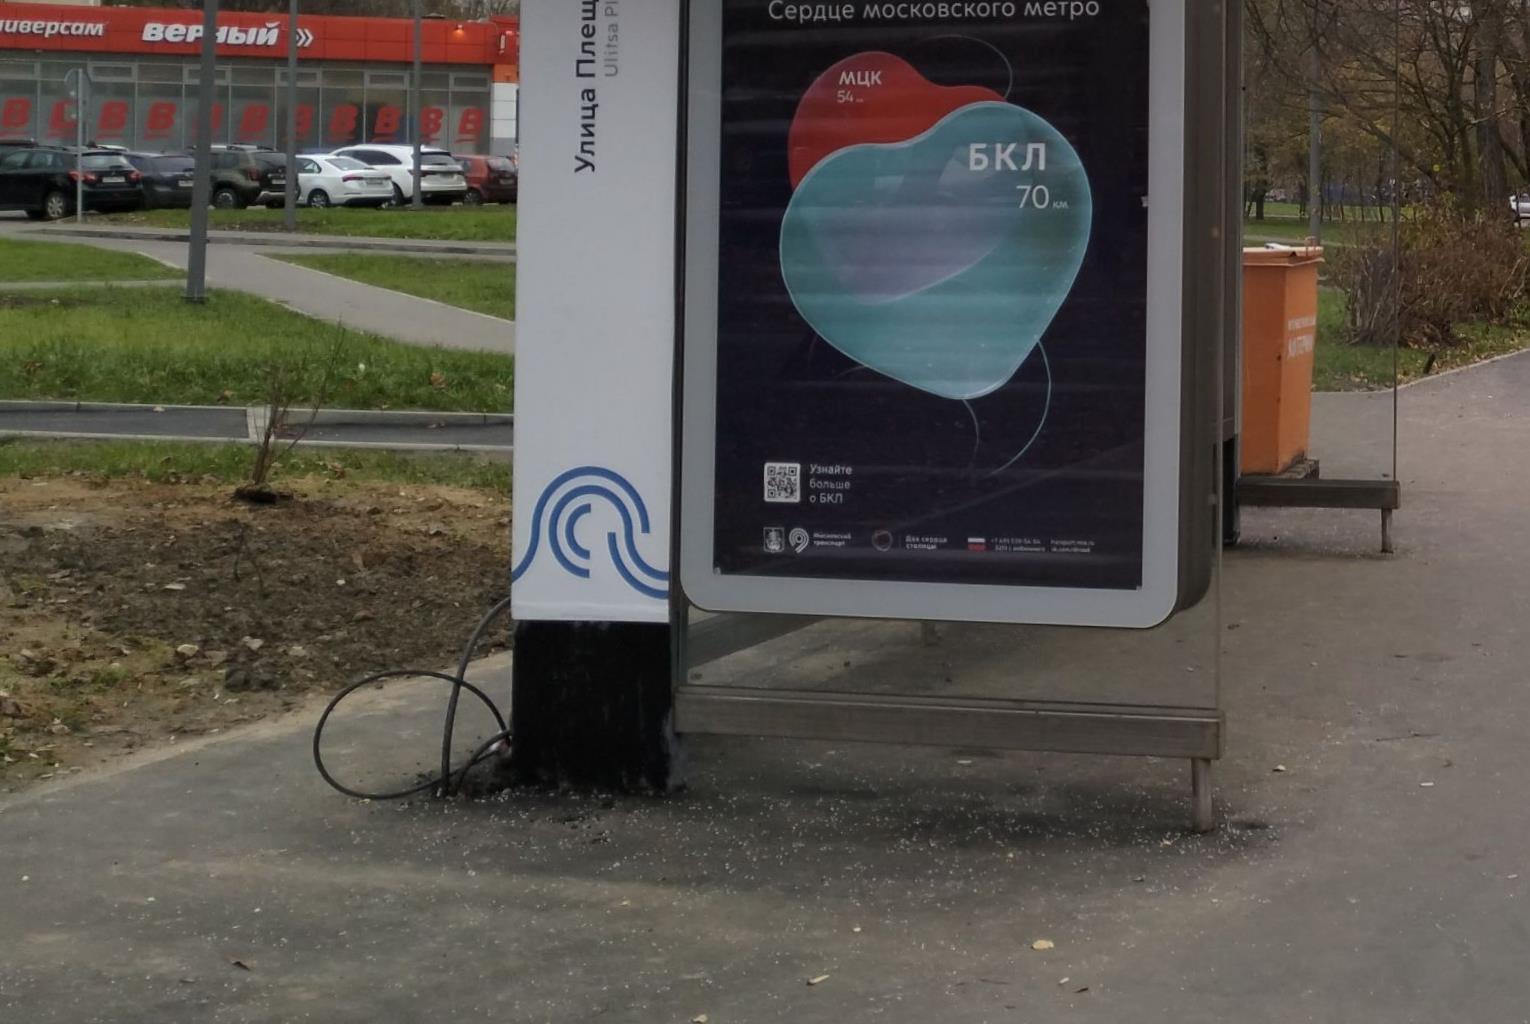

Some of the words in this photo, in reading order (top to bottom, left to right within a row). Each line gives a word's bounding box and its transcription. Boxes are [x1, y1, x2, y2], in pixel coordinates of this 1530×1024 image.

[768, 0, 855, 24] Сердце
[863, 1, 1016, 19] московского
[1024, 0, 1100, 21] метро
[603, 23, 619, 77] Ulitsa
[839, 70, 882, 87] МЦК
[837, 90, 854, 103] 54
[574, 88, 599, 173] Улица
[969, 142, 1046, 171] БКЛ
[1016, 184, 1049, 209] 70
[809, 463, 853, 475] Узнайте
[809, 478, 851, 490] больше
[809, 494, 817, 504] о
[819, 492, 844, 504] БКЛ
